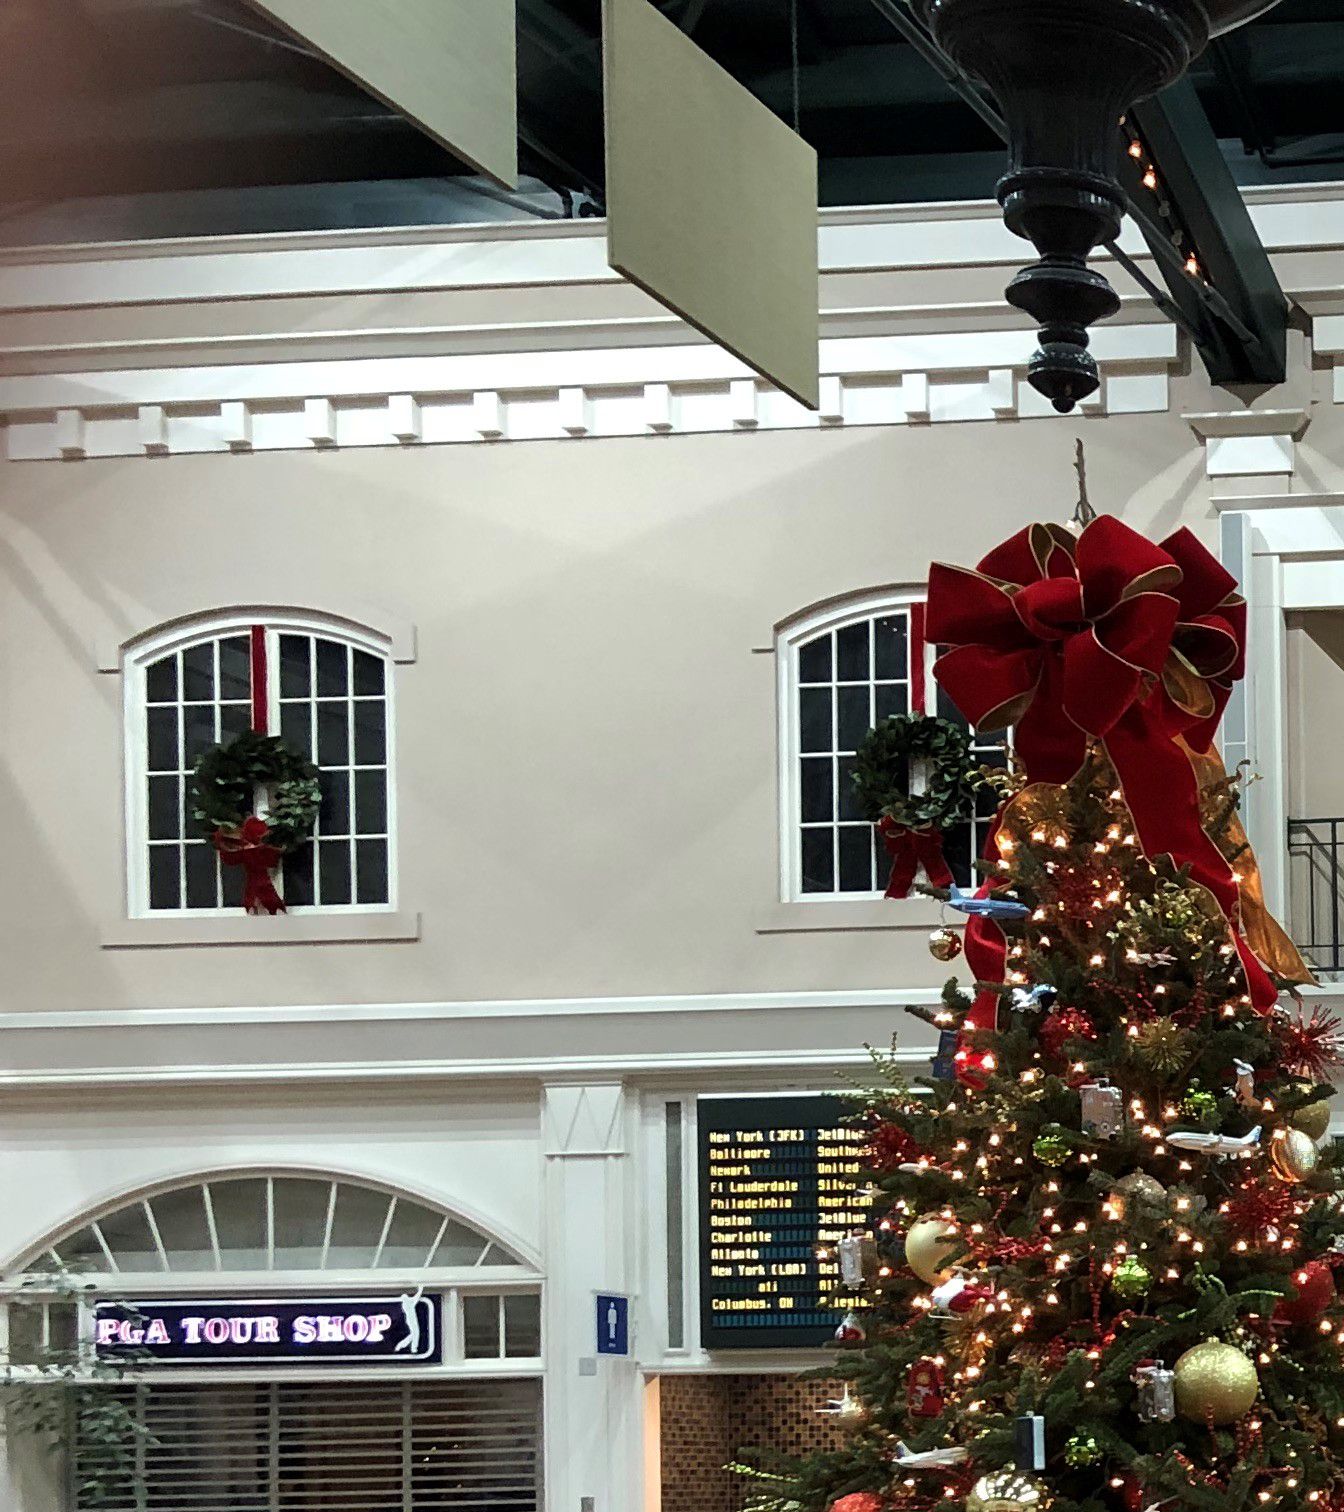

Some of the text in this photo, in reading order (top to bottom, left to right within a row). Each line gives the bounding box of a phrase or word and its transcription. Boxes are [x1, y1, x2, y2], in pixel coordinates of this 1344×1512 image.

[736, 1131, 763, 1142] York
[710, 1148, 770, 1159] Baltimore
[818, 1162, 861, 1173] United
[730, 1180, 798, 1192] Lauderdale
[711, 1198, 791, 1209] Philadelphia
[711, 1215, 752, 1226] Boston
[711, 1231, 771, 1243] Charlotte
[738, 1265, 765, 1276] York
[97, 1314, 391, 1344] PGA TOUR SHOP
